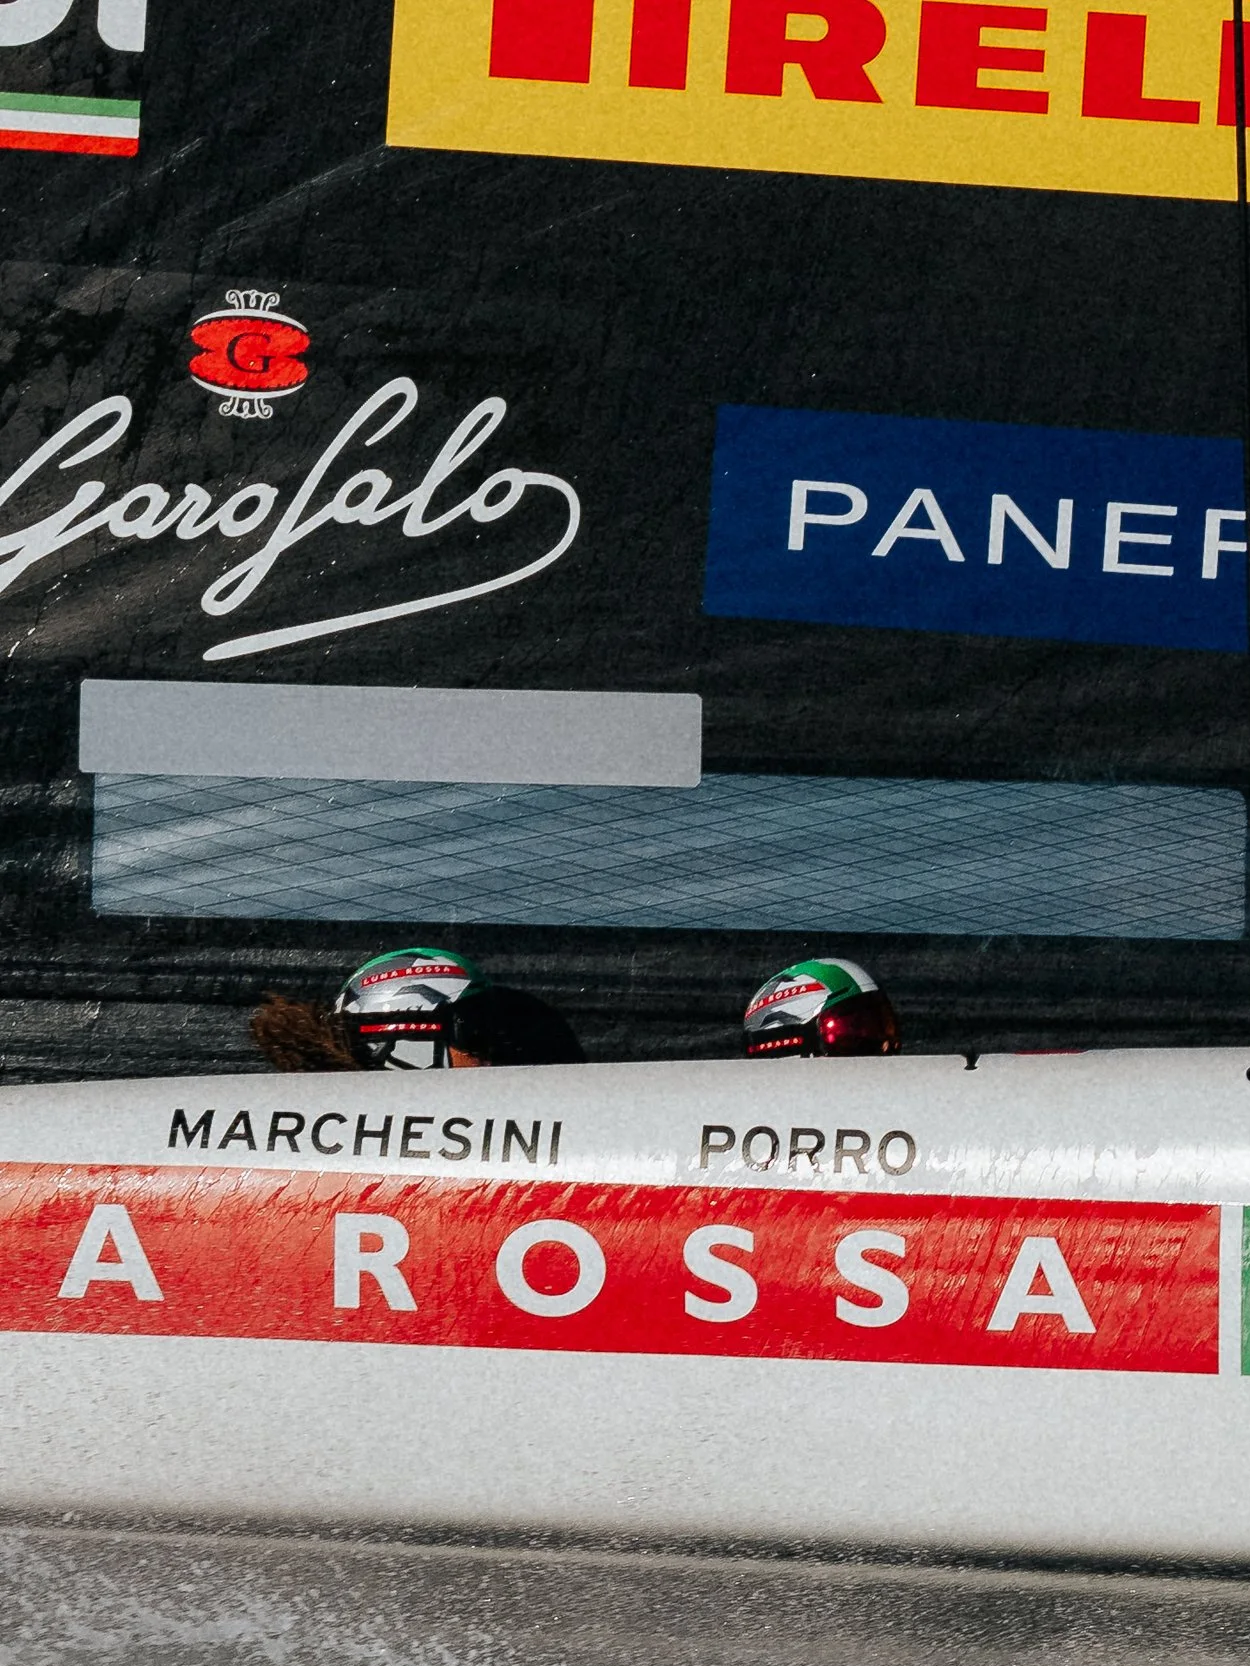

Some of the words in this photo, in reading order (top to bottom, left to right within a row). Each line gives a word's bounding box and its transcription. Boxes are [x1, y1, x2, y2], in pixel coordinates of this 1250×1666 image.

[226, 331, 277, 374] G
[0, 376, 580, 661] Garofalo
[363, 971, 398, 985] LUNA
[405, 965, 451, 975] ROSSA
[768, 985, 807, 1003] ROSSA
[167, 1108, 562, 1165] MARCHESINI
[700, 1124, 916, 1176] PORRO
[333, 1212, 1097, 1334] ROSSA
